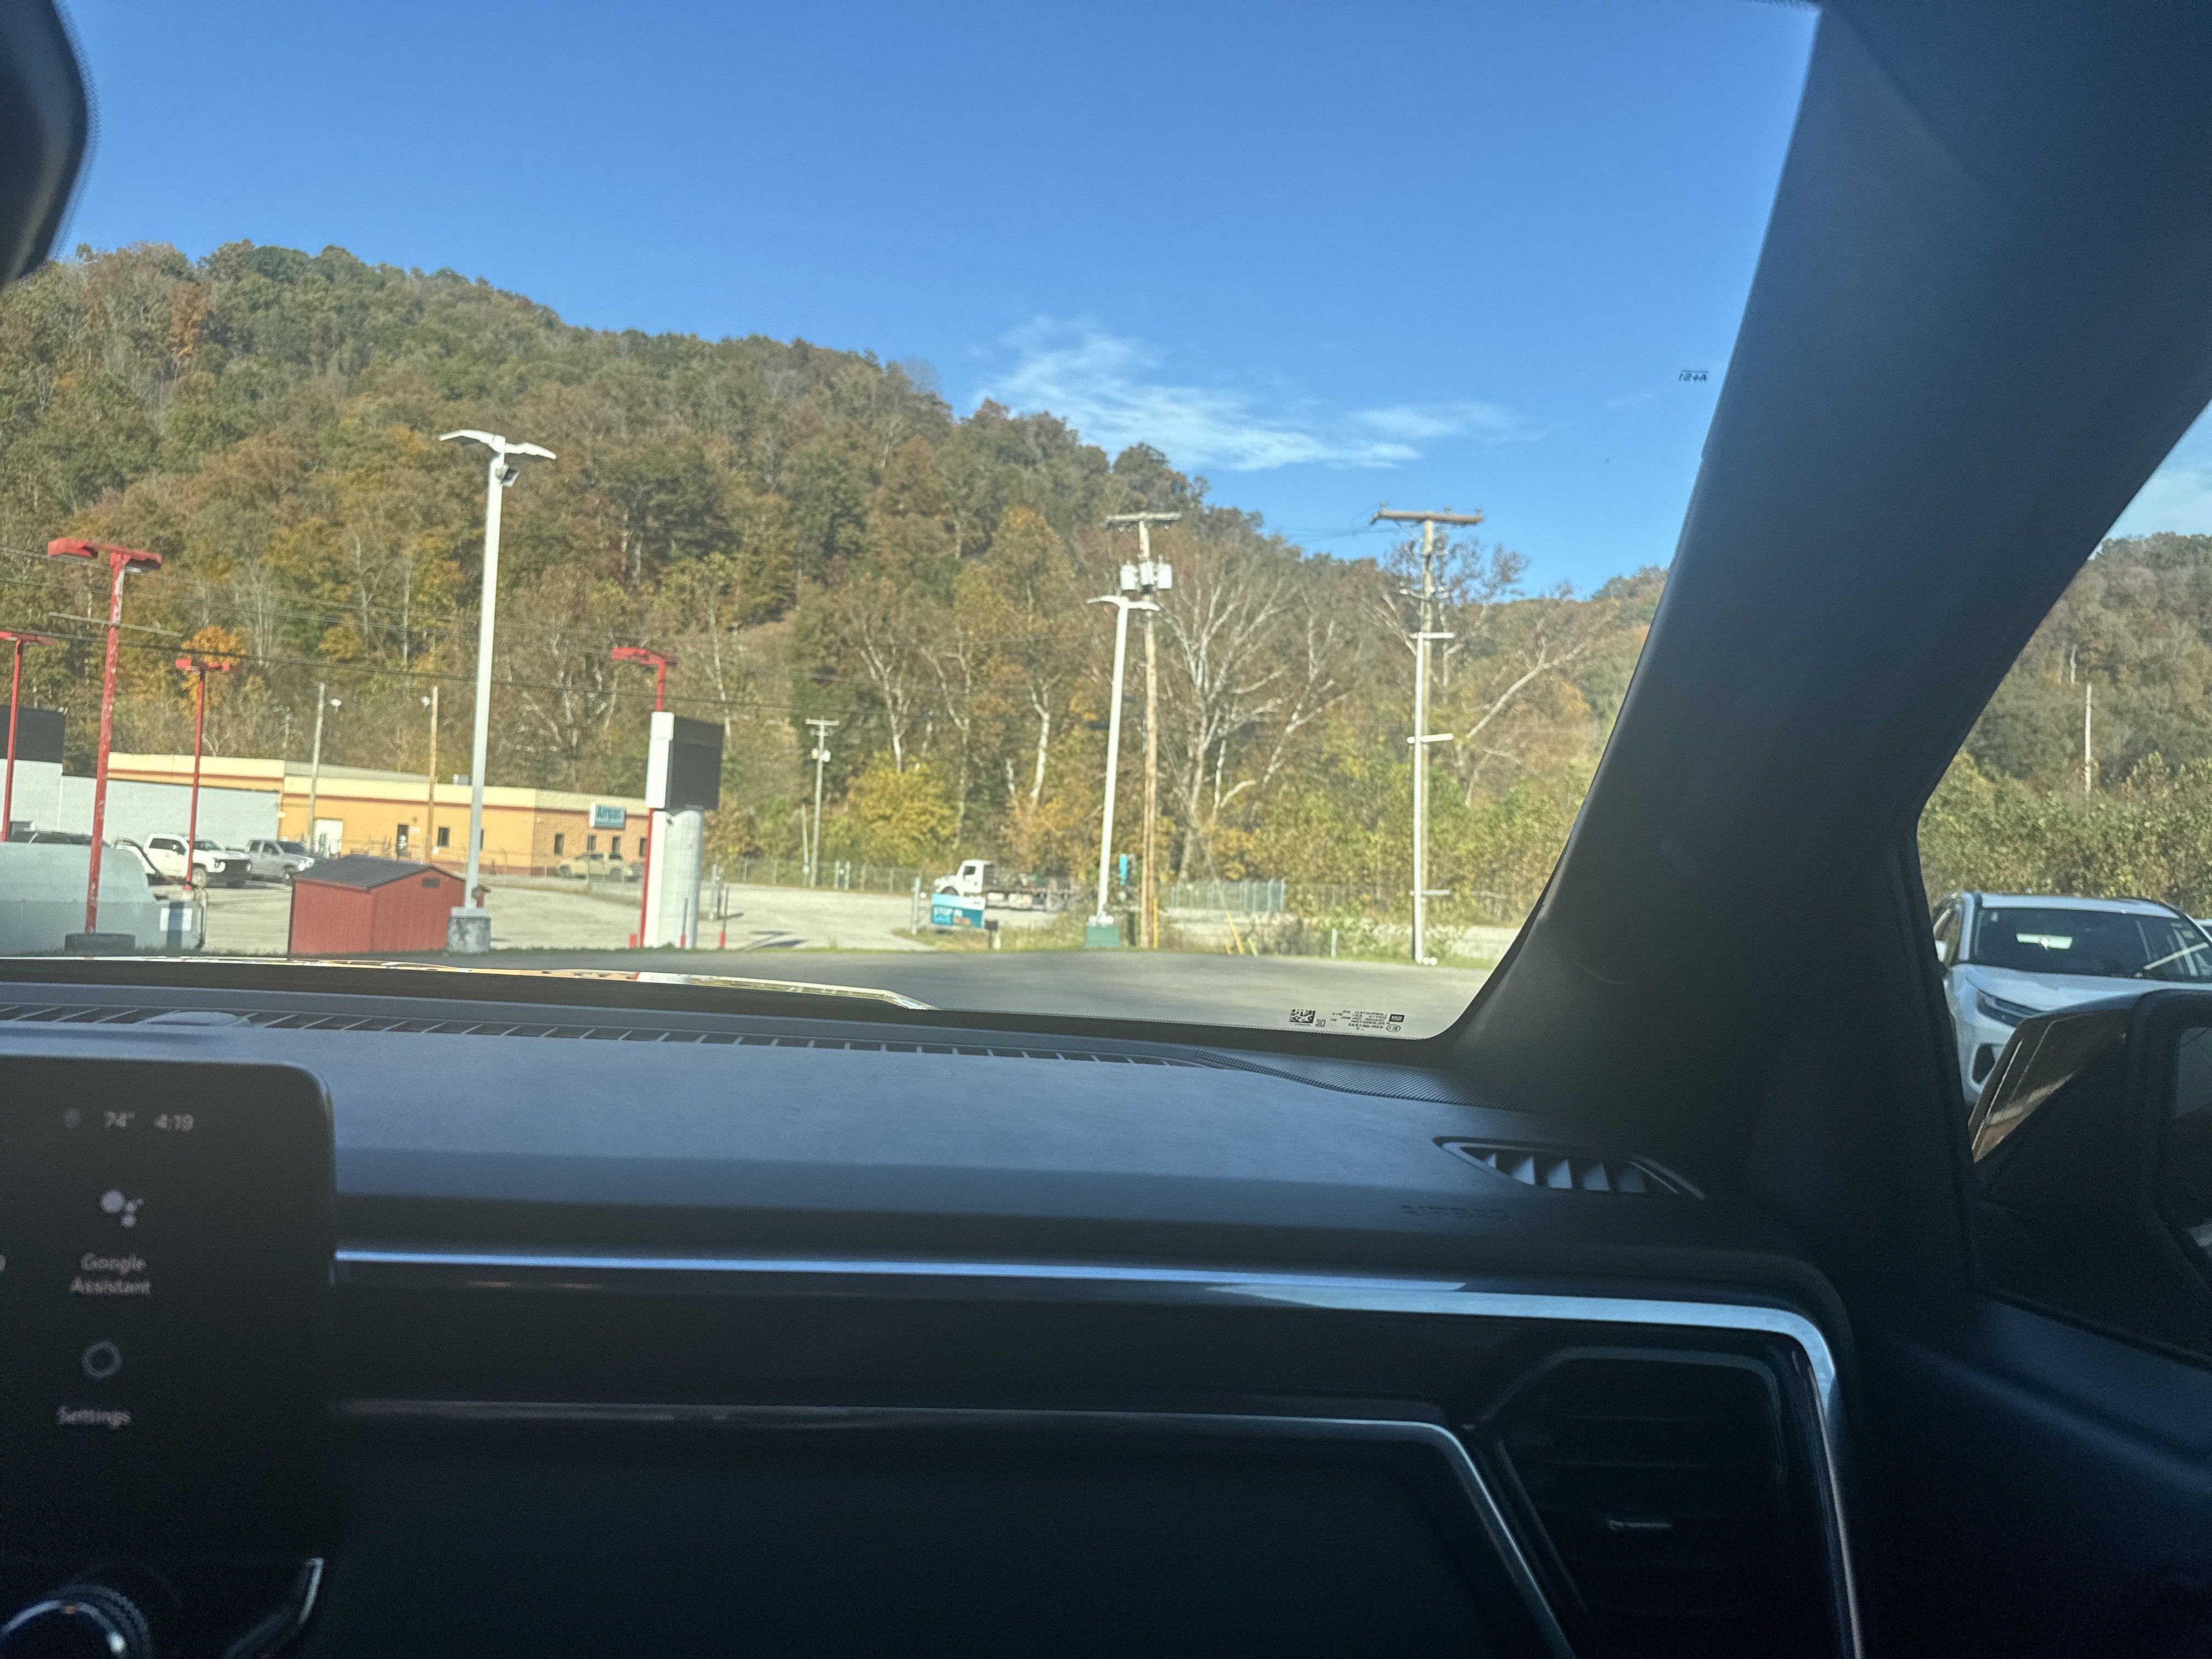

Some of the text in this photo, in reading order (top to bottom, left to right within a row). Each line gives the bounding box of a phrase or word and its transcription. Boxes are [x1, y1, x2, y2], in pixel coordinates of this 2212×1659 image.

[597, 806, 622, 820] Airgas
[933, 907, 953, 915] STOP
[155, 1112, 194, 1131] 4:19
[81, 1252, 146, 1275] Google
[70, 1276, 151, 1295] Assistant
[57, 1406, 131, 1429] Settings
